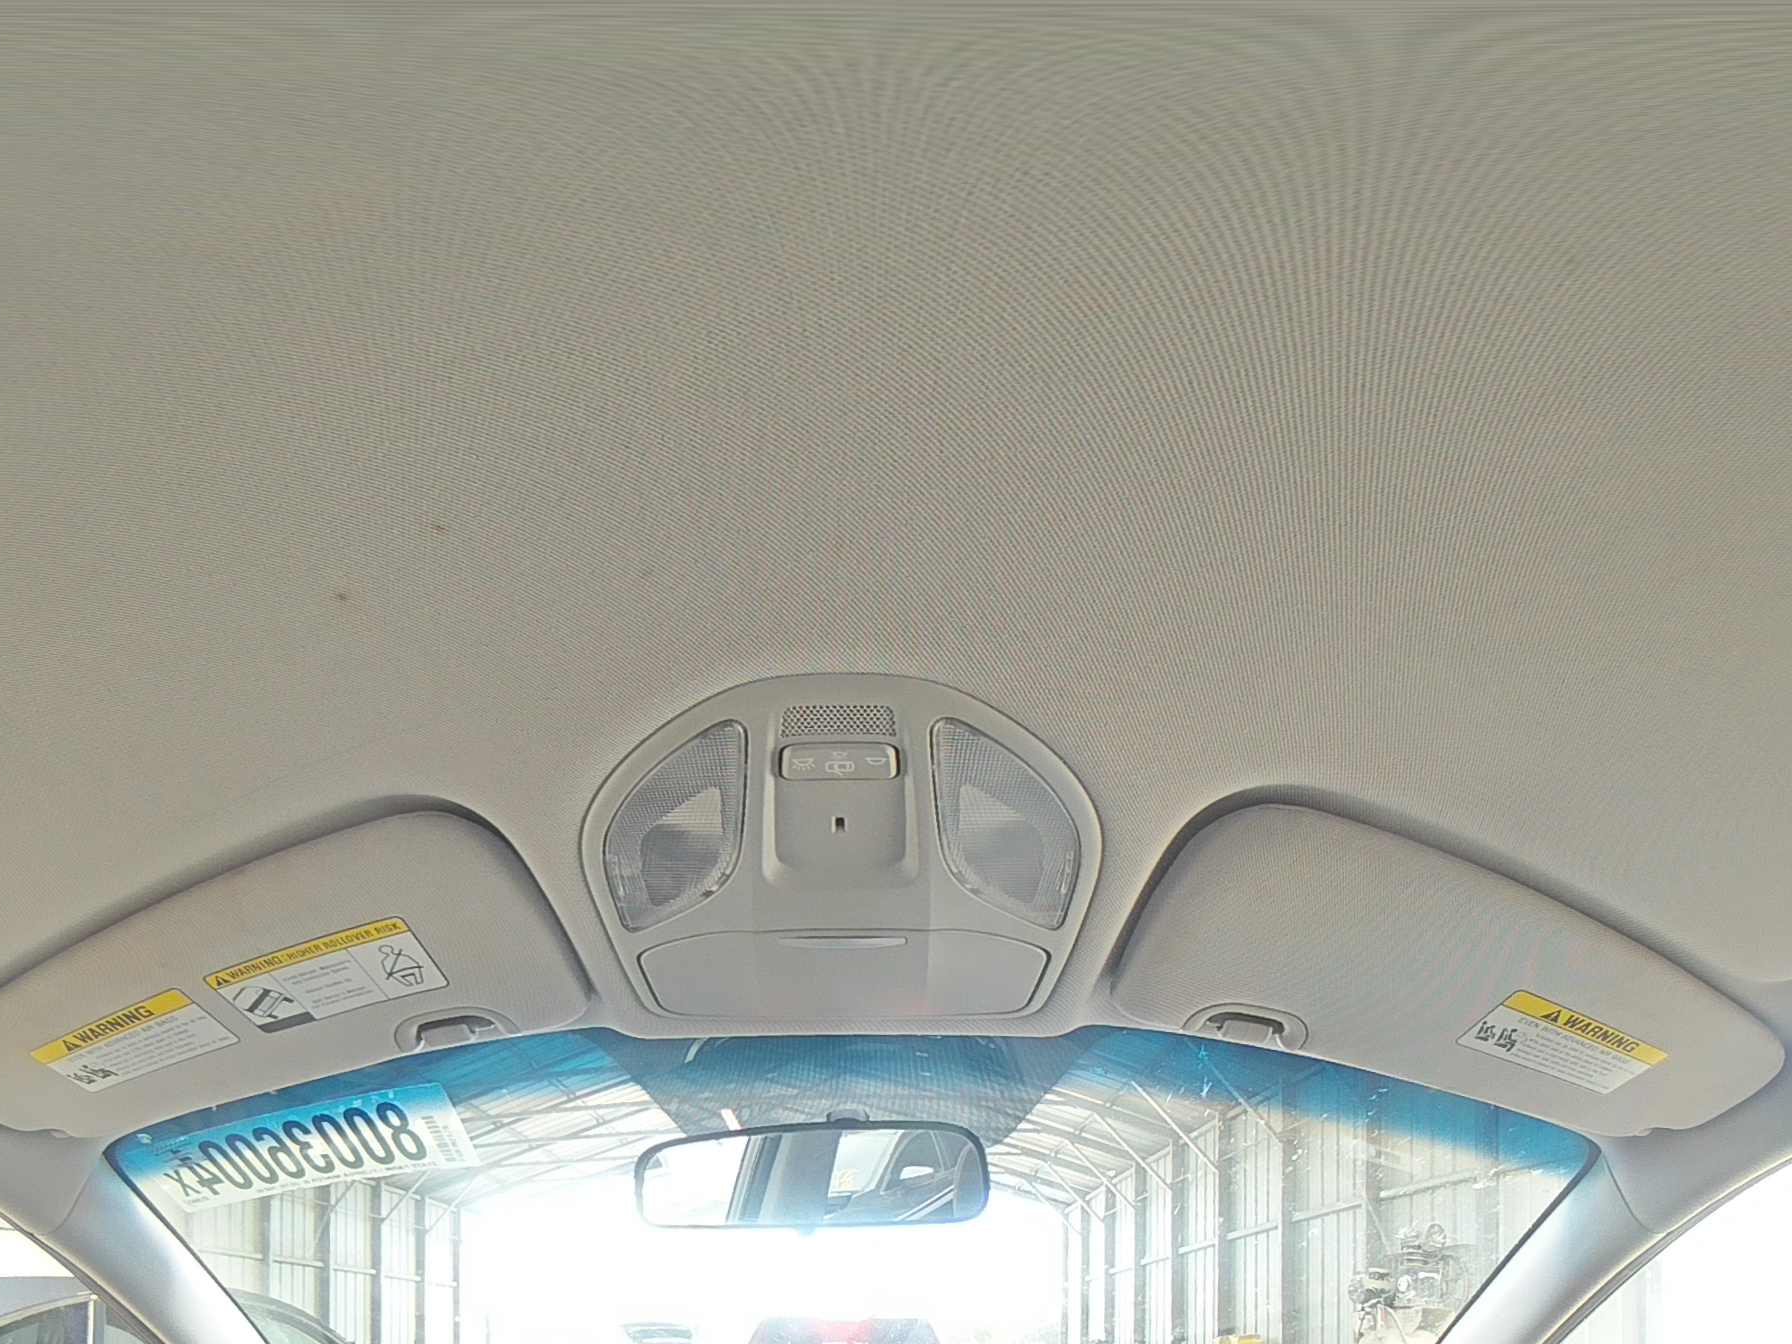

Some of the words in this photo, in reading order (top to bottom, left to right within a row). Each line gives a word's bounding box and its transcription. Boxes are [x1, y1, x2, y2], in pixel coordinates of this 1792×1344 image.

[287, 942, 322, 962] HIGHER
[322, 929, 373, 953] ROLLOVER
[373, 921, 401, 938] RISK
[72, 1004, 155, 1044] WARNING
[1562, 1013, 1640, 1054] WARNING
